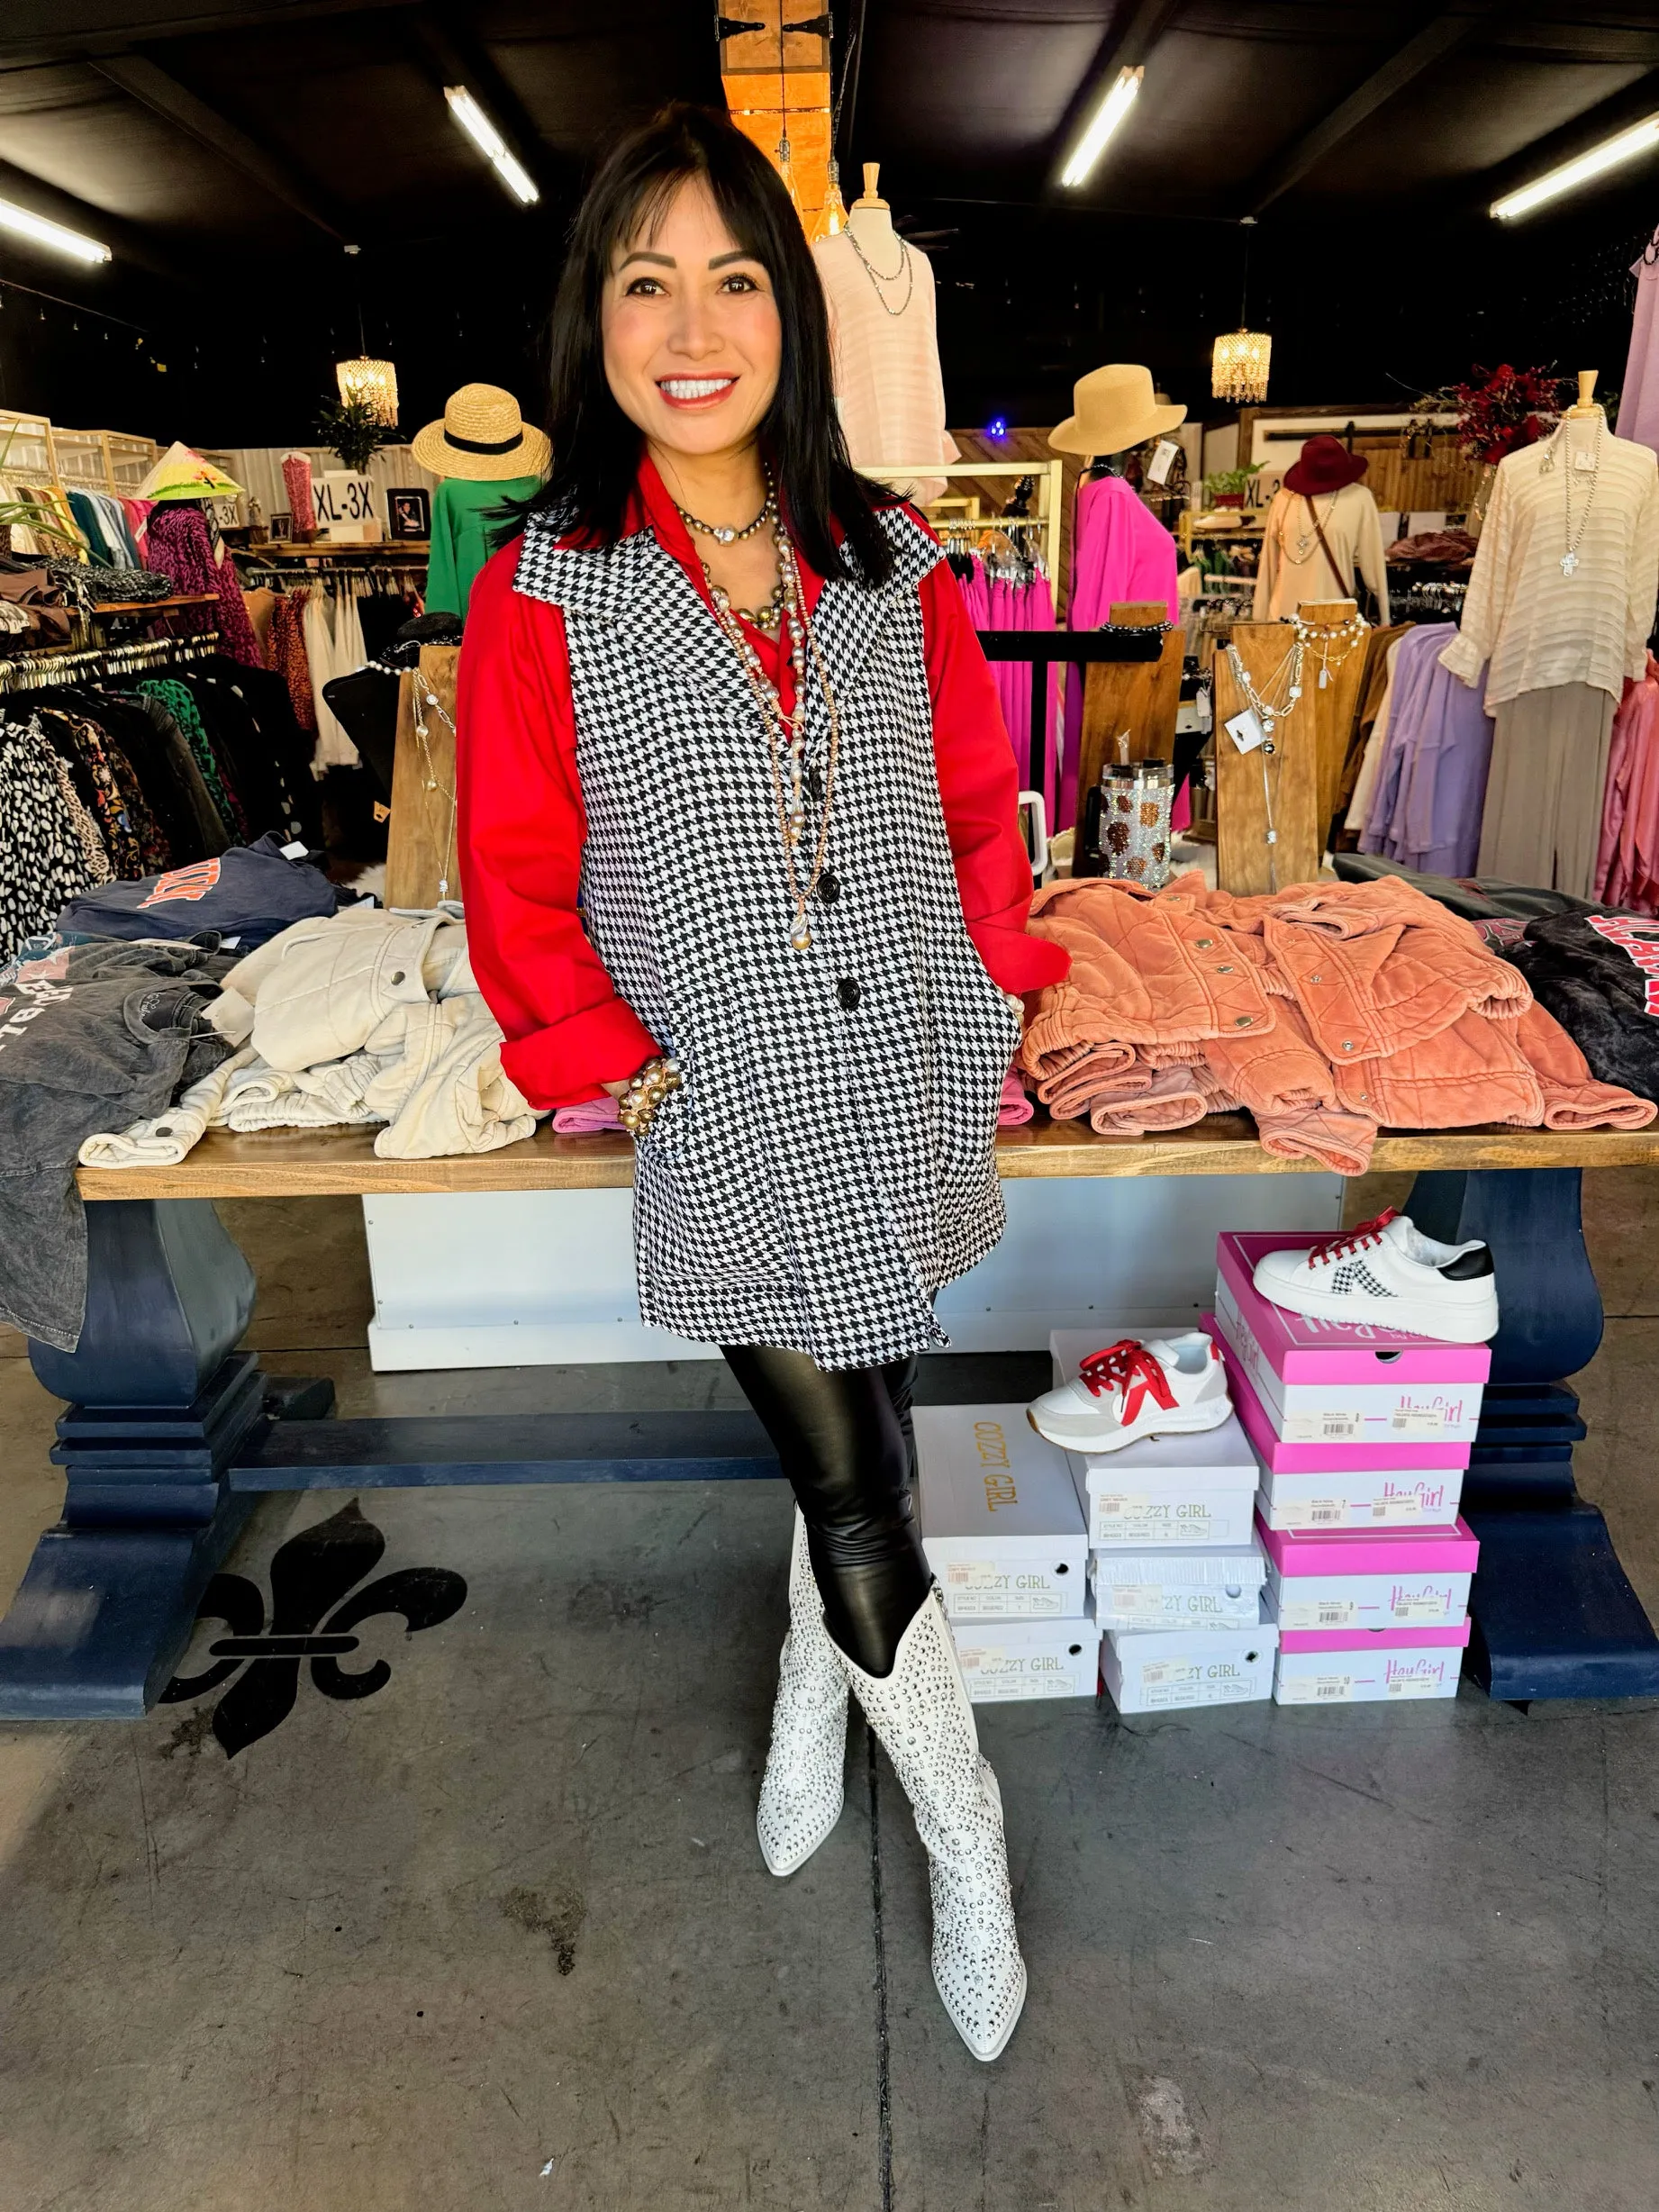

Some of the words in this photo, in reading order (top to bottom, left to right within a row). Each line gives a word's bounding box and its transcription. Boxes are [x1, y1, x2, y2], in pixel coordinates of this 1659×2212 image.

[313, 481, 375, 521] XL-3X
[1400, 1395, 1463, 1423] HGirl
[974, 1421, 1011, 1468] COZZY
[984, 1473, 1018, 1512] GIRL
[1383, 1482, 1445, 1508] HGirl
[1123, 1504, 1172, 1520] ZZY
[1175, 1504, 1211, 1518] GIRL
[1015, 1574, 1050, 1590] GIRL
[1187, 1596, 1223, 1613] GIRL
[1030, 1657, 1064, 1671] GIRL
[1207, 1664, 1241, 1678] GIRL
